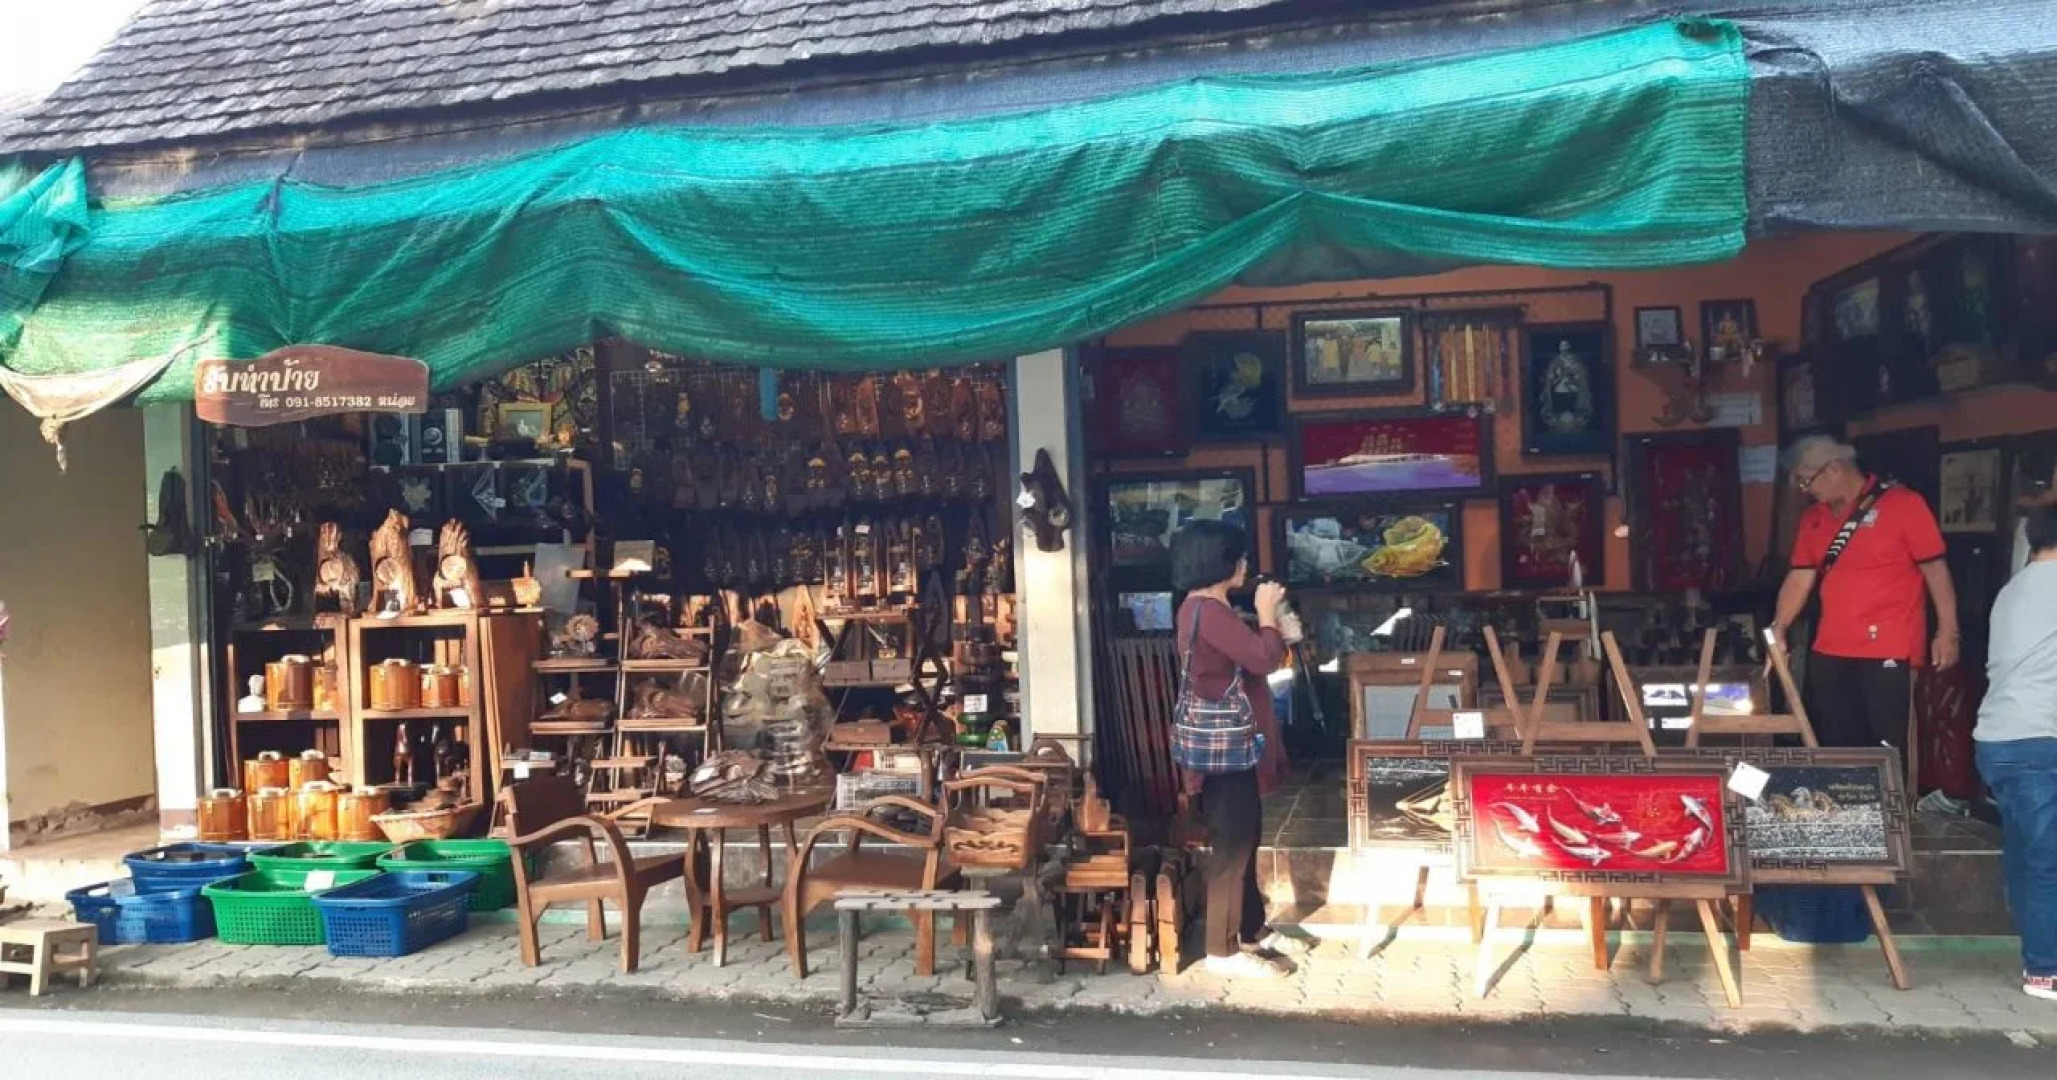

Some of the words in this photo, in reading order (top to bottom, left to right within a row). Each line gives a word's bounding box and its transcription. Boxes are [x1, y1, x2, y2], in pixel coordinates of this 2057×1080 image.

[204, 360, 320, 394] รับทำป้าย
[286, 397, 371, 408] 091-8517382
